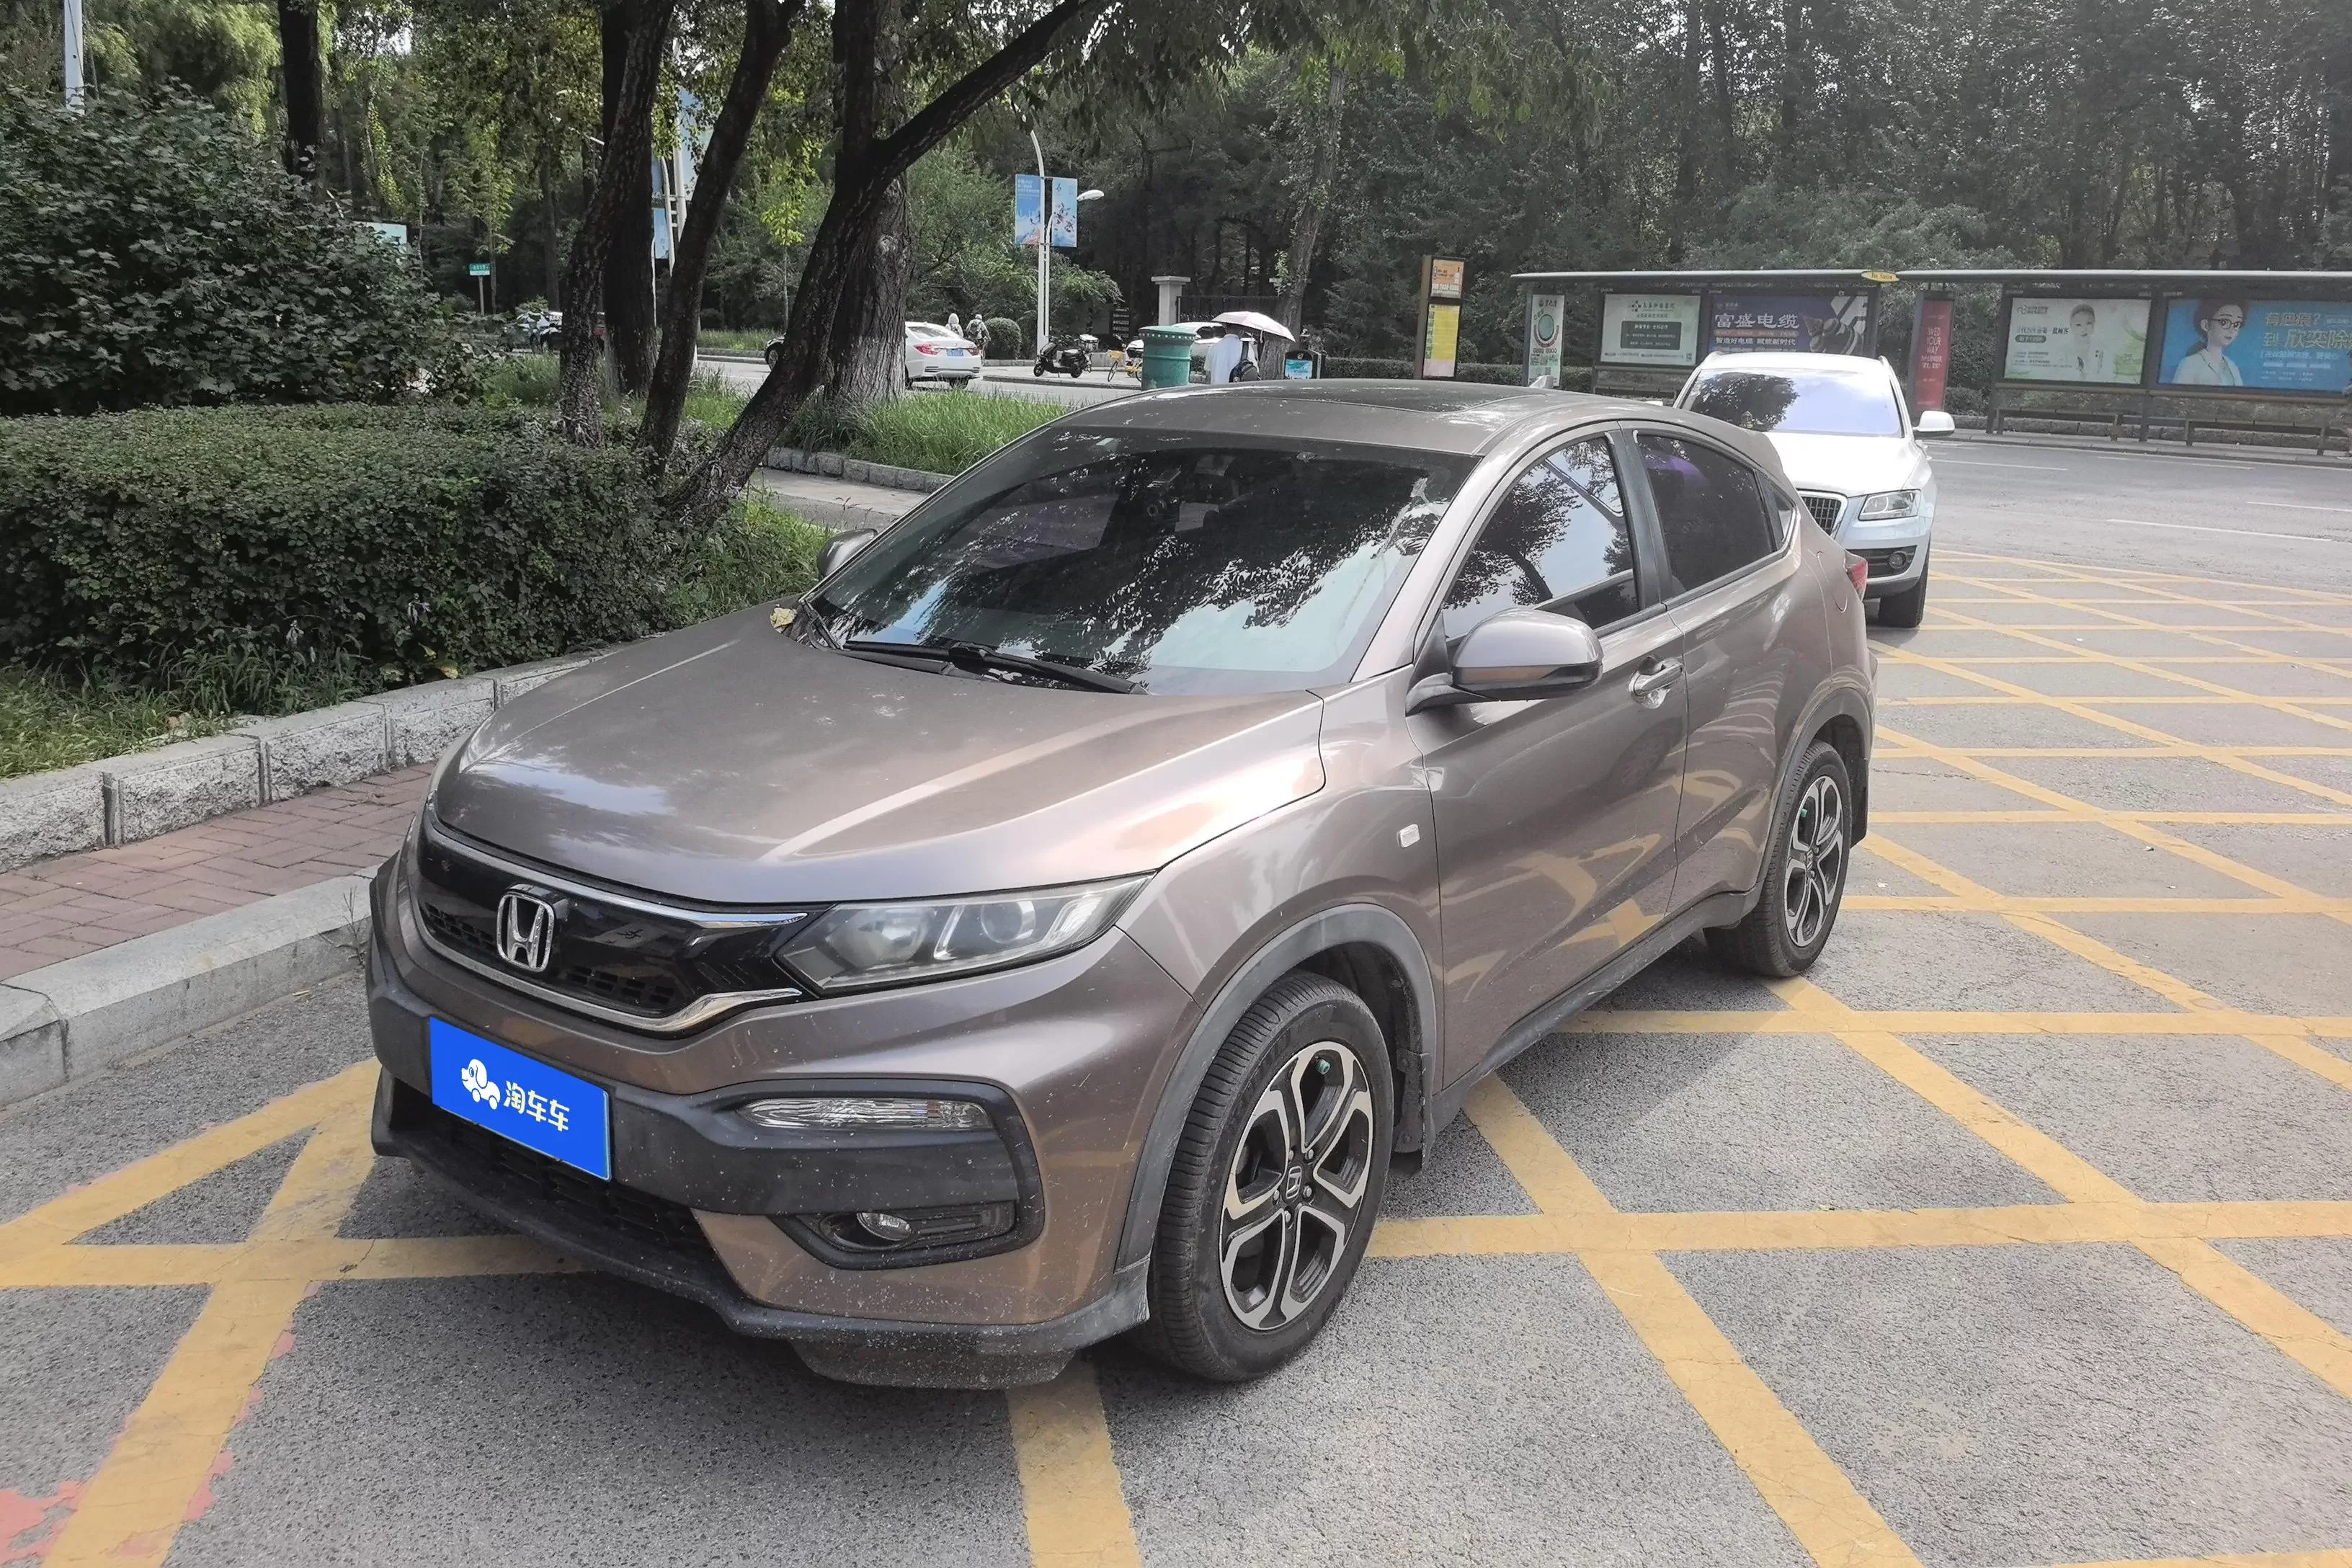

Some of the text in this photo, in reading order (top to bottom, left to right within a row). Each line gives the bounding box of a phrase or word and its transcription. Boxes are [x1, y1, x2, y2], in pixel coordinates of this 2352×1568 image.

[1714, 312, 1799, 329] 富盛电缆
[2284, 329, 2352, 349] 欣奕除
